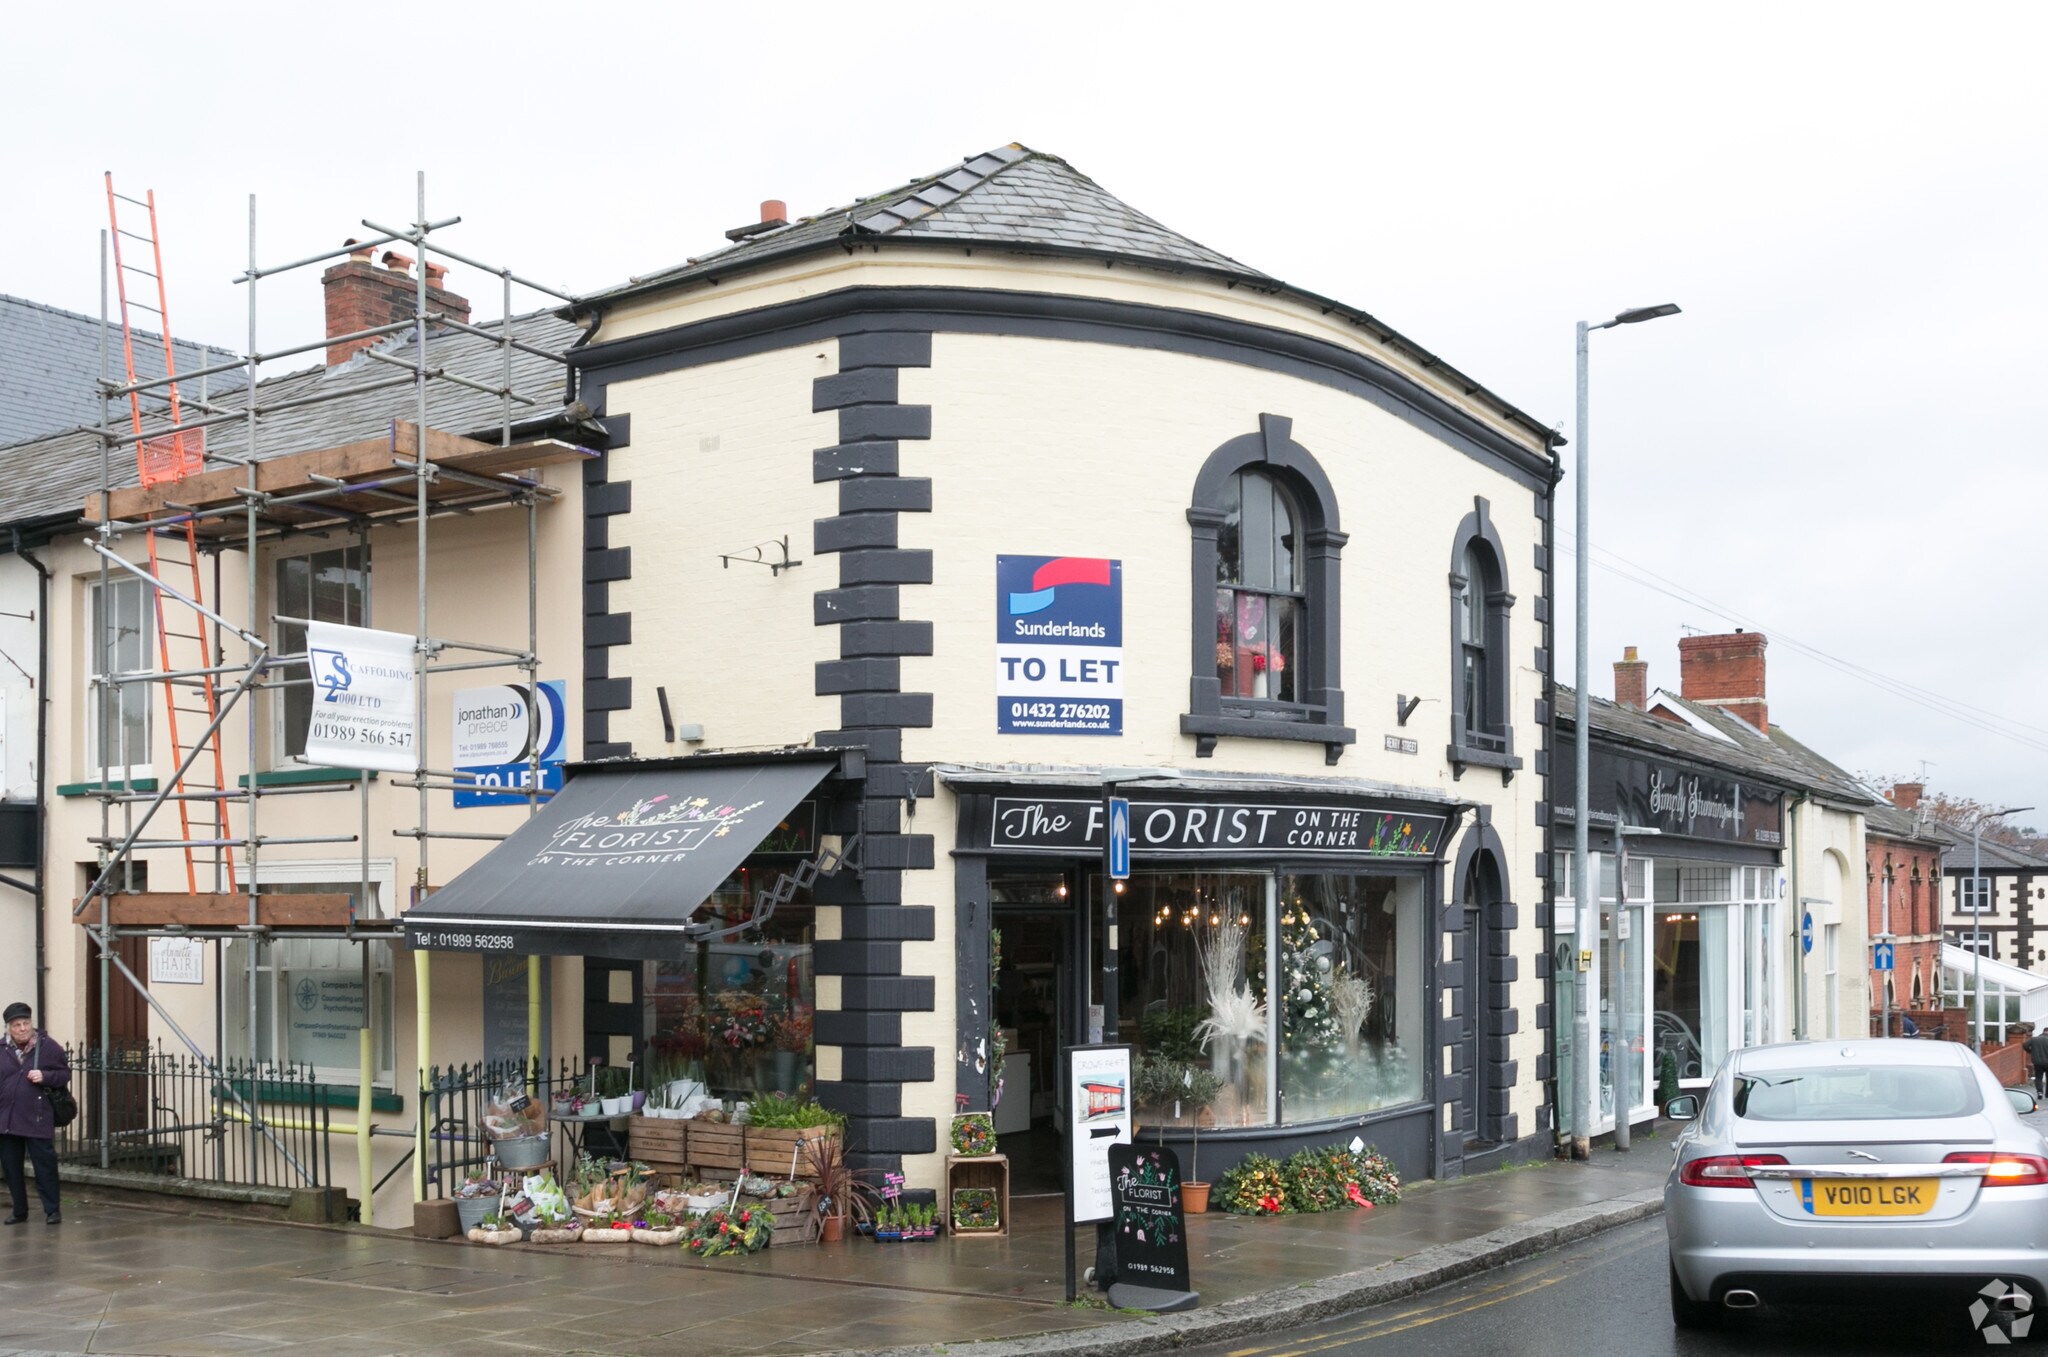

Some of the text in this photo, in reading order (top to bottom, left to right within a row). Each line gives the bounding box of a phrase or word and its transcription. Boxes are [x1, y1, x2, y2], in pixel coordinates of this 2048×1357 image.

[1015, 619, 1106, 638] Sunderlands
[1000, 657, 1119, 683] TO LET
[358, 695, 381, 709] LTD
[1011, 703, 1110, 719] 01432 276202
[314, 709, 414, 730] For all your erection problems!
[457, 704, 508, 725] jonathan
[468, 719, 508, 738] preece
[1012, 720, 1110, 729] www.sunderlands.co.uk
[313, 722, 412, 748] 01989 566 547
[1401, 739, 1416, 752] STREET
[475, 772, 501, 796] TO
[1650, 769, 1728, 829] Simply Stunning
[552, 811, 611, 839] The
[1000, 803, 1277, 844] The FORIST
[1294, 810, 1361, 828] ON THE
[560, 827, 701, 849] FLORIST
[1287, 829, 1358, 847] CORNER
[527, 852, 685, 867] ON THE CORNER
[414, 932, 431, 946] Tel
[439, 932, 472, 948] 01989
[474, 934, 514, 950] 562958
[161, 957, 193, 971] HAIR
[321, 981, 349, 990] Compass
[321, 994, 354, 1004] Counselling
[323, 1004, 363, 1014] Psychotherapy
[1117, 1174, 1139, 1192] The
[1128, 1187, 1163, 1201] FLORIST
[1825, 1186, 1921, 1205] VO10 LGK
[1136, 1205, 1149, 1214] THE
[1151, 1208, 1172, 1217] CORNER
[1127, 1262, 1175, 1275] 01989 562958
